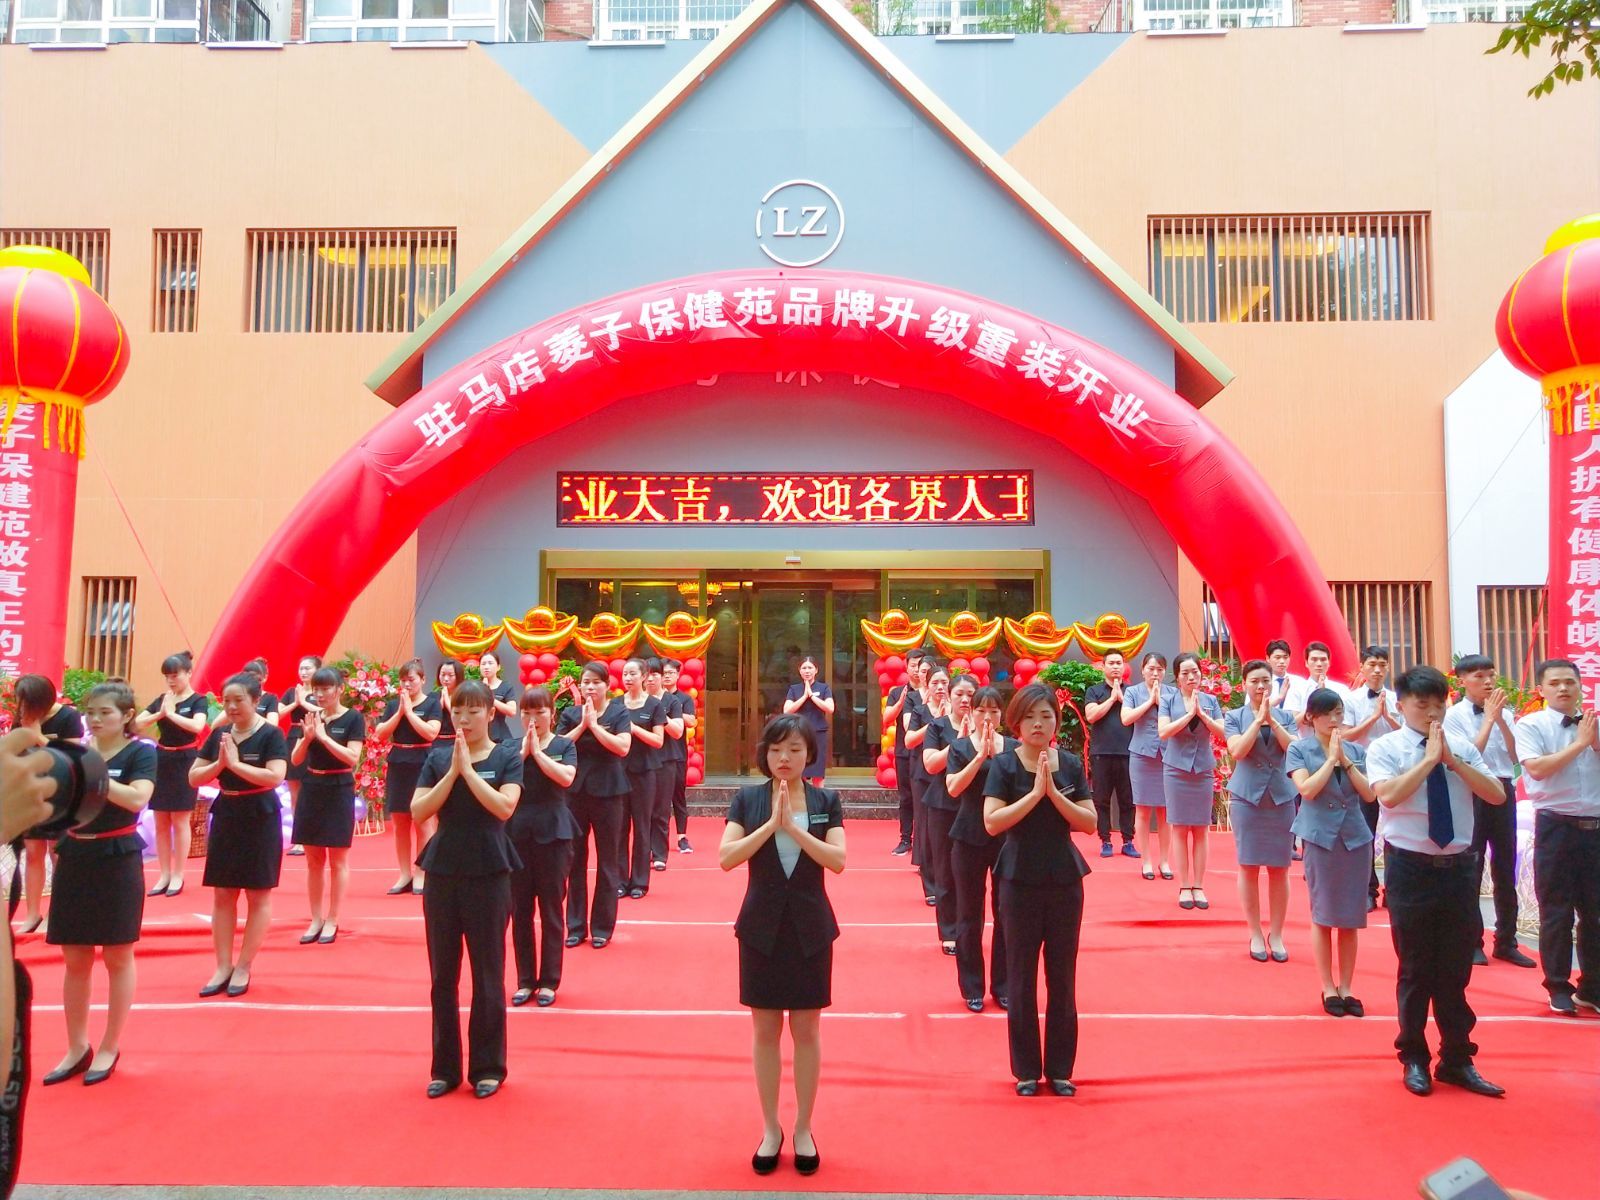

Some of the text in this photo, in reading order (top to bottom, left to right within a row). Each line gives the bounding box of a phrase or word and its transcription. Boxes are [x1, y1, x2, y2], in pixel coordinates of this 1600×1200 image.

[773, 206, 828, 237] LZ
[413, 287, 1149, 447] 驻马店菱子保健苑品牌升级重装开业
[562, 479, 1028, 521] 业大吉,欢迎各界人士
